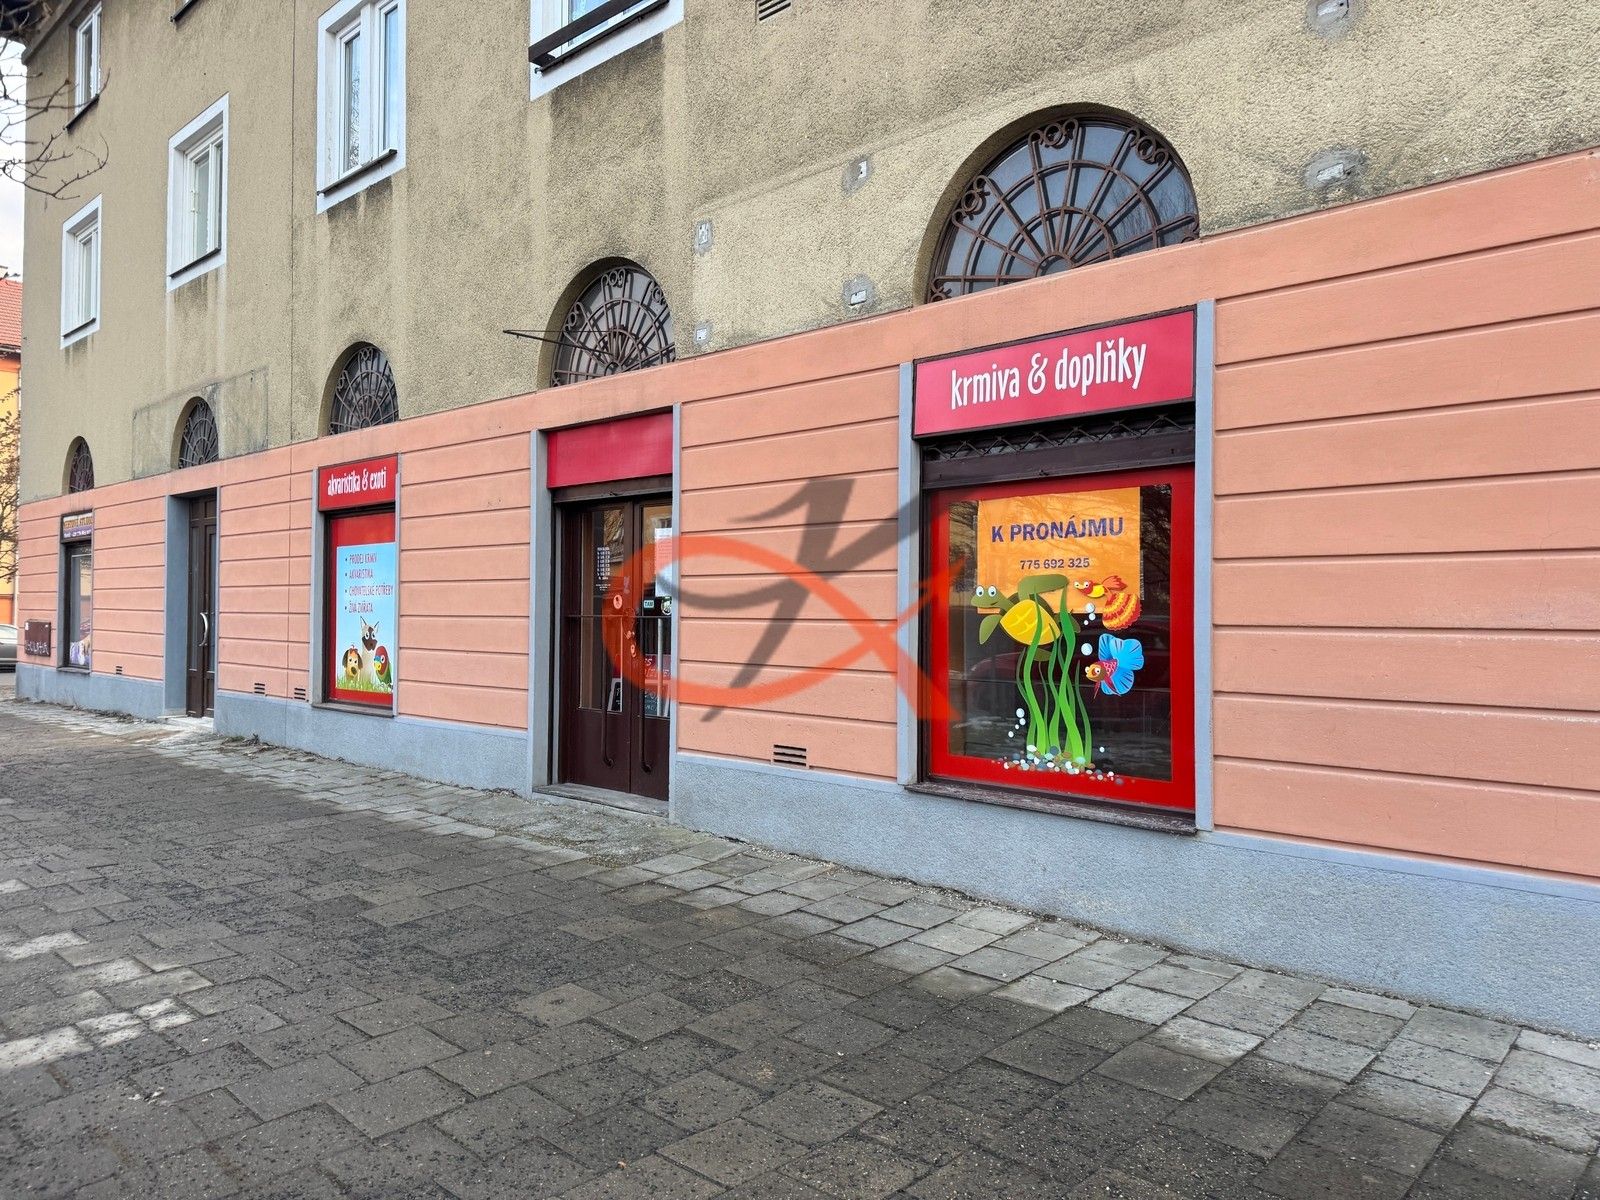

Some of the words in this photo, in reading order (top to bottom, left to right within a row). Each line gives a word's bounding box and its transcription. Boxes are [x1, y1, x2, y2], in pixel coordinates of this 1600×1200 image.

[951, 364, 1020, 410] krmiva
[1027, 352, 1049, 395] &
[1054, 337, 1147, 396] doplňky
[327, 470, 361, 496] akvaristika
[362, 468, 369, 491] &
[370, 466, 387, 489] exoti
[991, 525, 1004, 543] K
[1010, 515, 1124, 541] PRONÁJMU
[1020, 559, 1040, 570] 775
[1043, 558, 1064, 569] 692
[1068, 557, 1090, 568] 325
